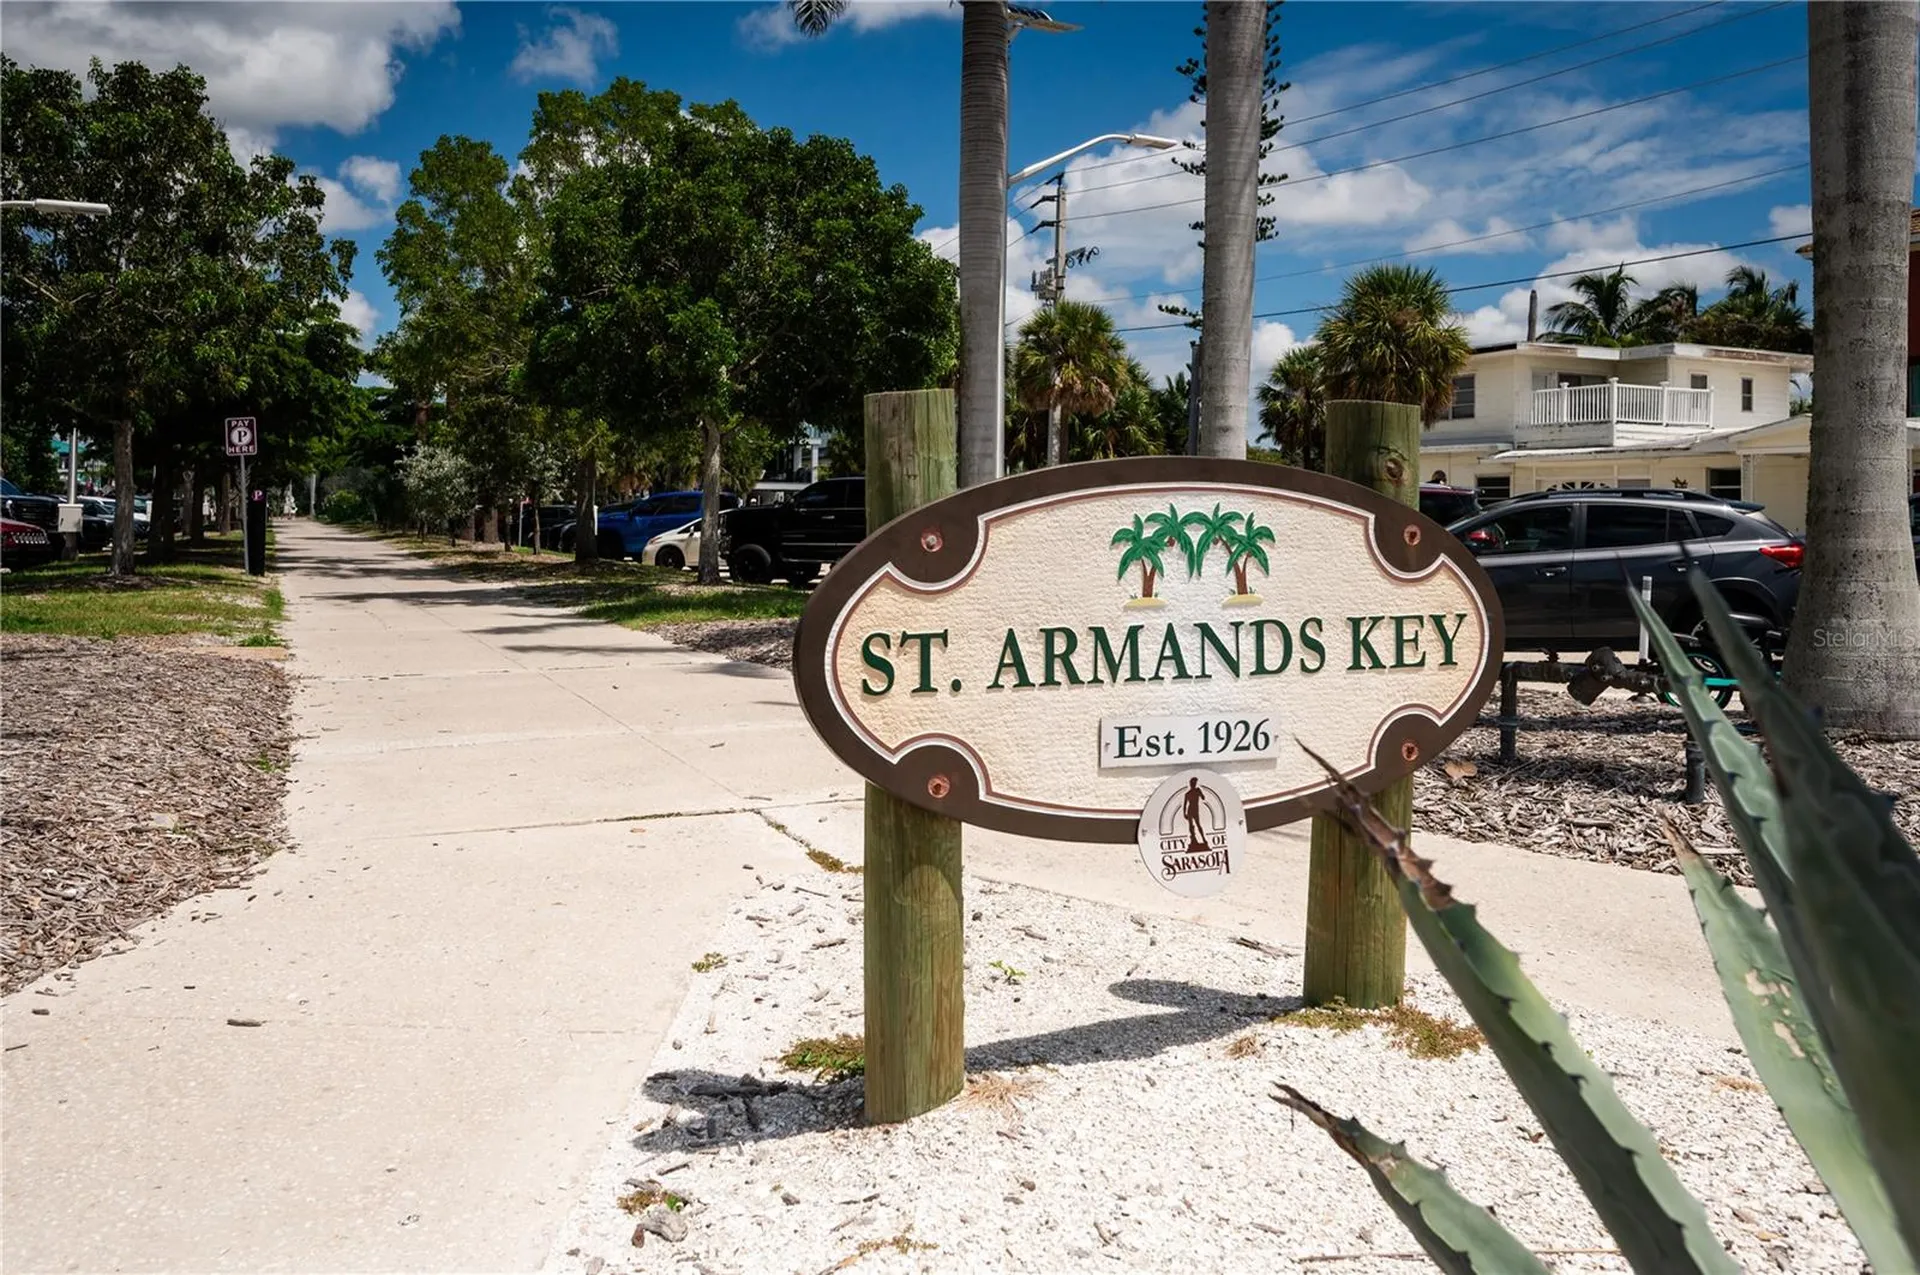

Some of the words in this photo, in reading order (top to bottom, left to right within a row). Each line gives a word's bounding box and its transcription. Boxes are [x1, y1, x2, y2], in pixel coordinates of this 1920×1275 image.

[237, 430, 248, 443] P
[228, 445, 255, 453] HERE
[253, 490, 263, 501] P
[862, 629, 962, 696] ST.
[986, 617, 1326, 688] ARMANDS
[1346, 613, 1468, 671] KEY
[1113, 725, 1185, 759] Est.
[1198, 718, 1270, 754] 1926
[1160, 838, 1186, 850] CITY
[1212, 834, 1227, 845] OF
[1161, 849, 1231, 881] SARASOTA
